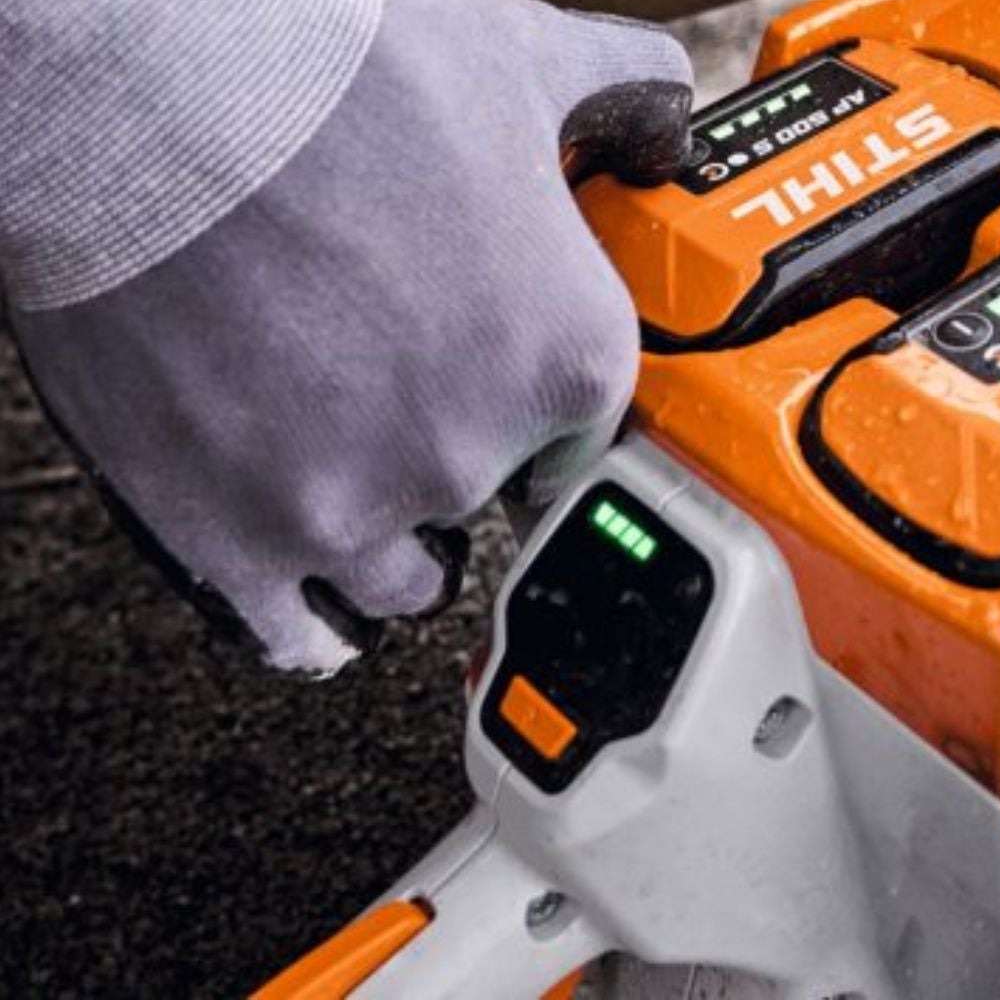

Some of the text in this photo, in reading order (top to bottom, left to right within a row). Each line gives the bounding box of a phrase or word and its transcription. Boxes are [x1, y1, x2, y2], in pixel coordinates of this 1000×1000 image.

[832, 88, 866, 117] AP
[775, 109, 830, 145] 500
[730, 103, 953, 227] STIHL
